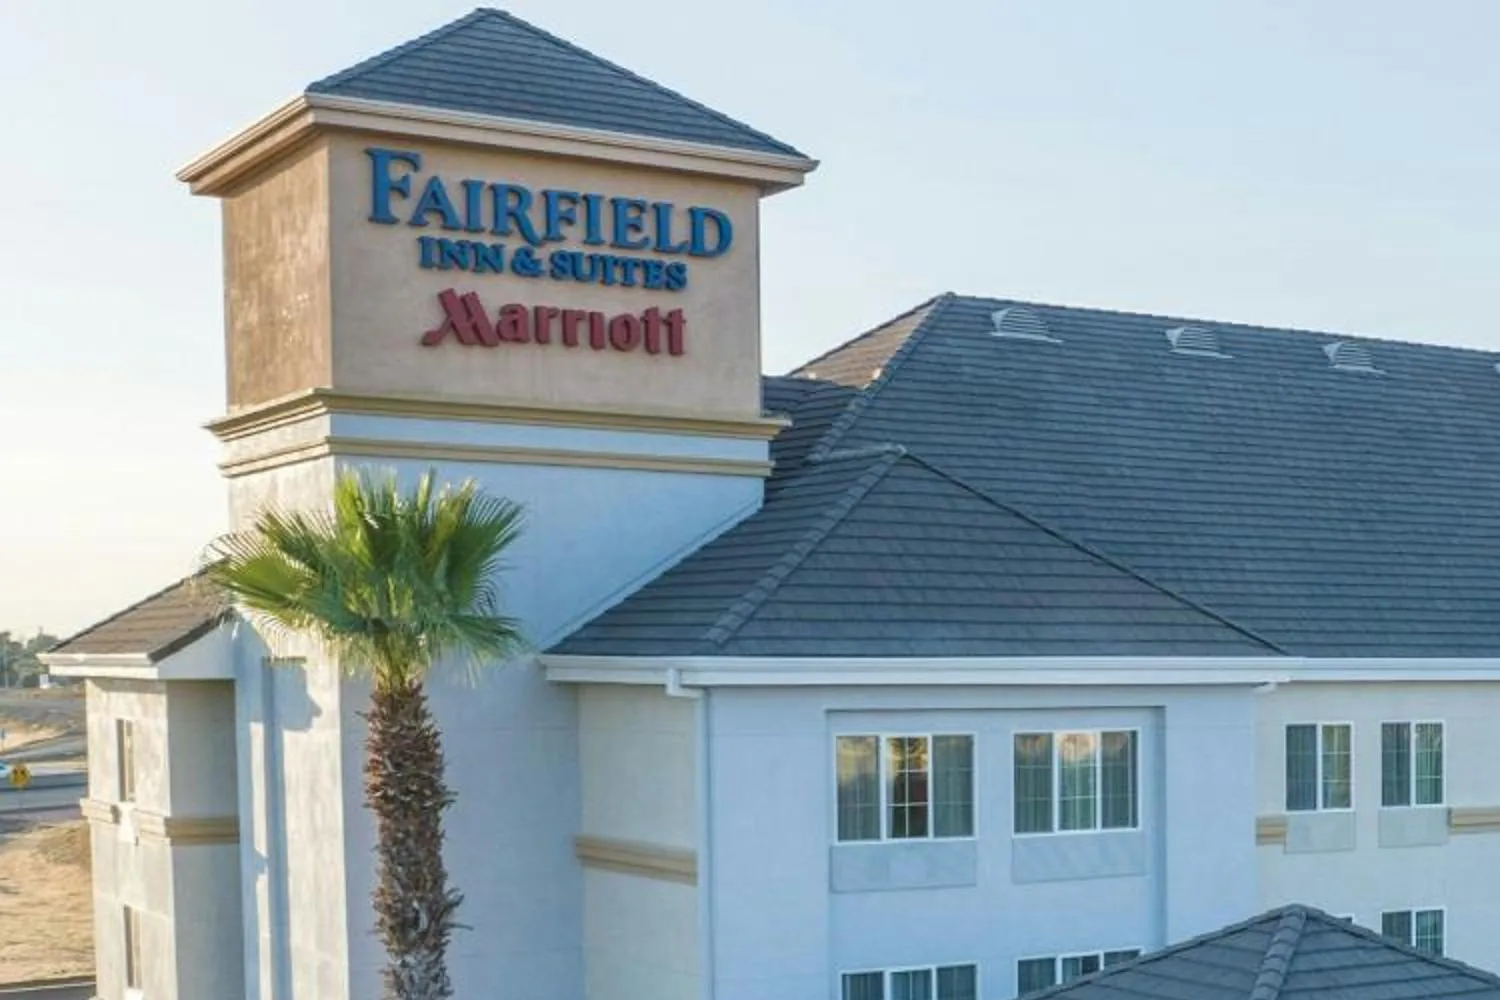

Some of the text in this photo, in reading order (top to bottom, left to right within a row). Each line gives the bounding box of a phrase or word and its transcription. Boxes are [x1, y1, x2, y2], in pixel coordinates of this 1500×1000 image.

[364, 147, 734, 258] FAIRFIELD
[416, 235, 689, 291] INN & SUITES
[420, 287, 688, 357] Marriott
